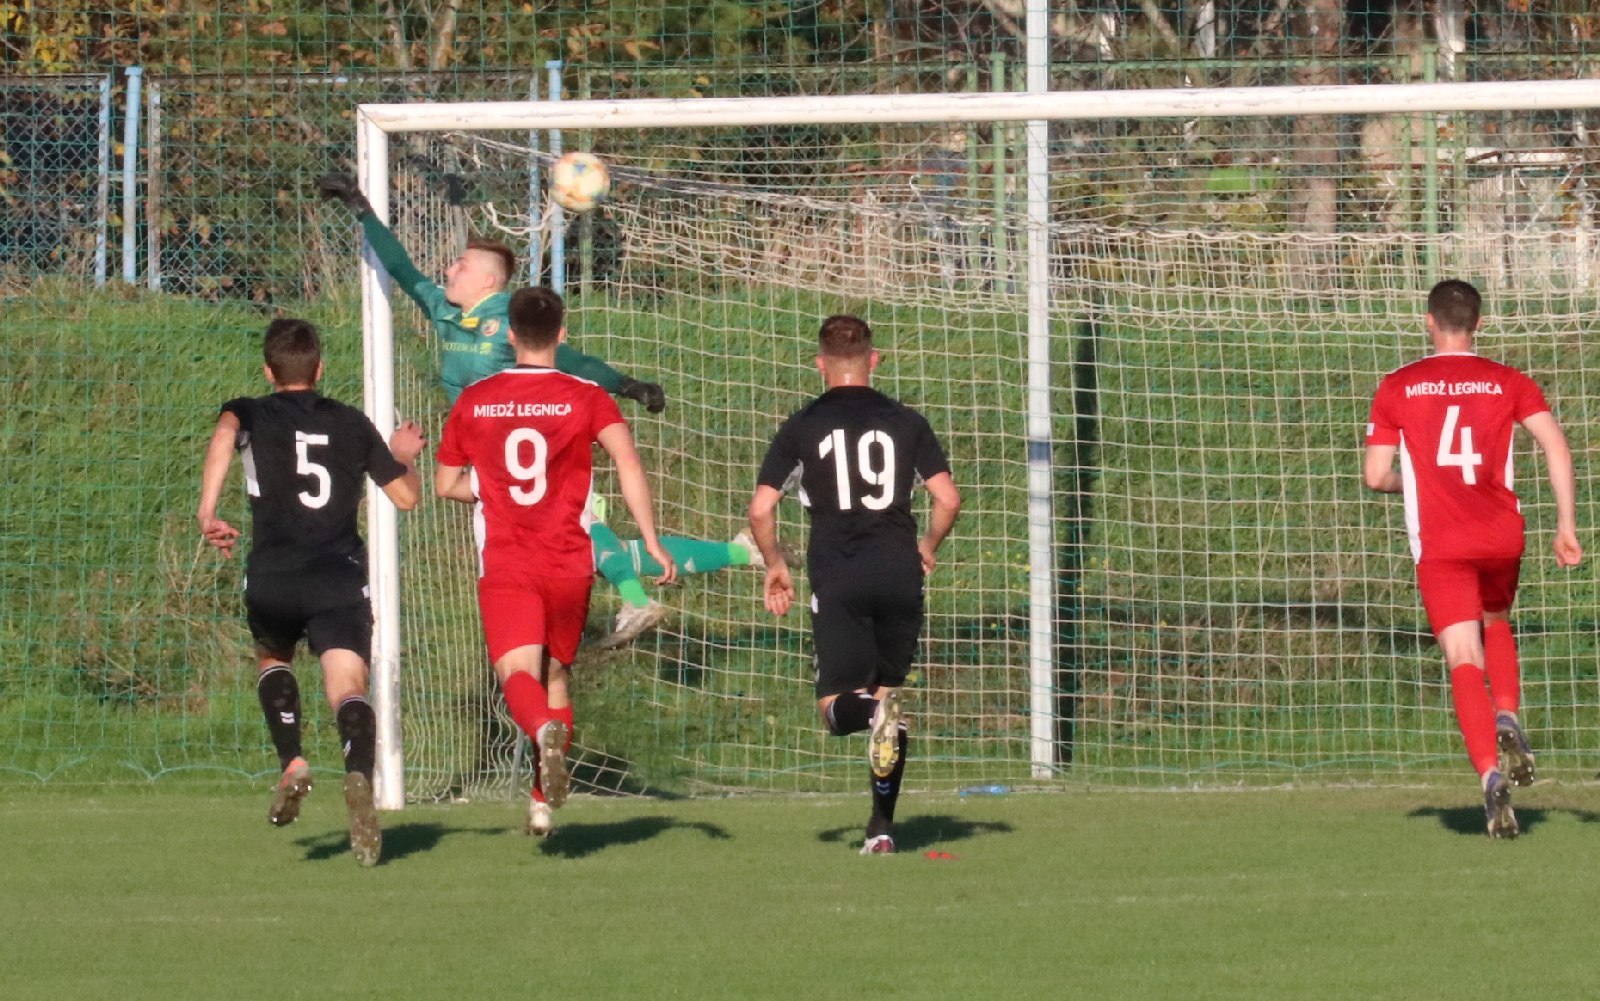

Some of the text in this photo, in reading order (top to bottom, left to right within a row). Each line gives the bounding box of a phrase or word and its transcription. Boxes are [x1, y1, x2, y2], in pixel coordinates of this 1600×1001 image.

[474, 400, 572, 418] MIEDŹ LEGNICA
[1405, 379, 1502, 398] MIEDŹ LEGNICA
[295, 430, 331, 509] 5
[504, 427, 548, 506] 9
[818, 428, 895, 510] 19
[1436, 405, 1482, 485] 4
